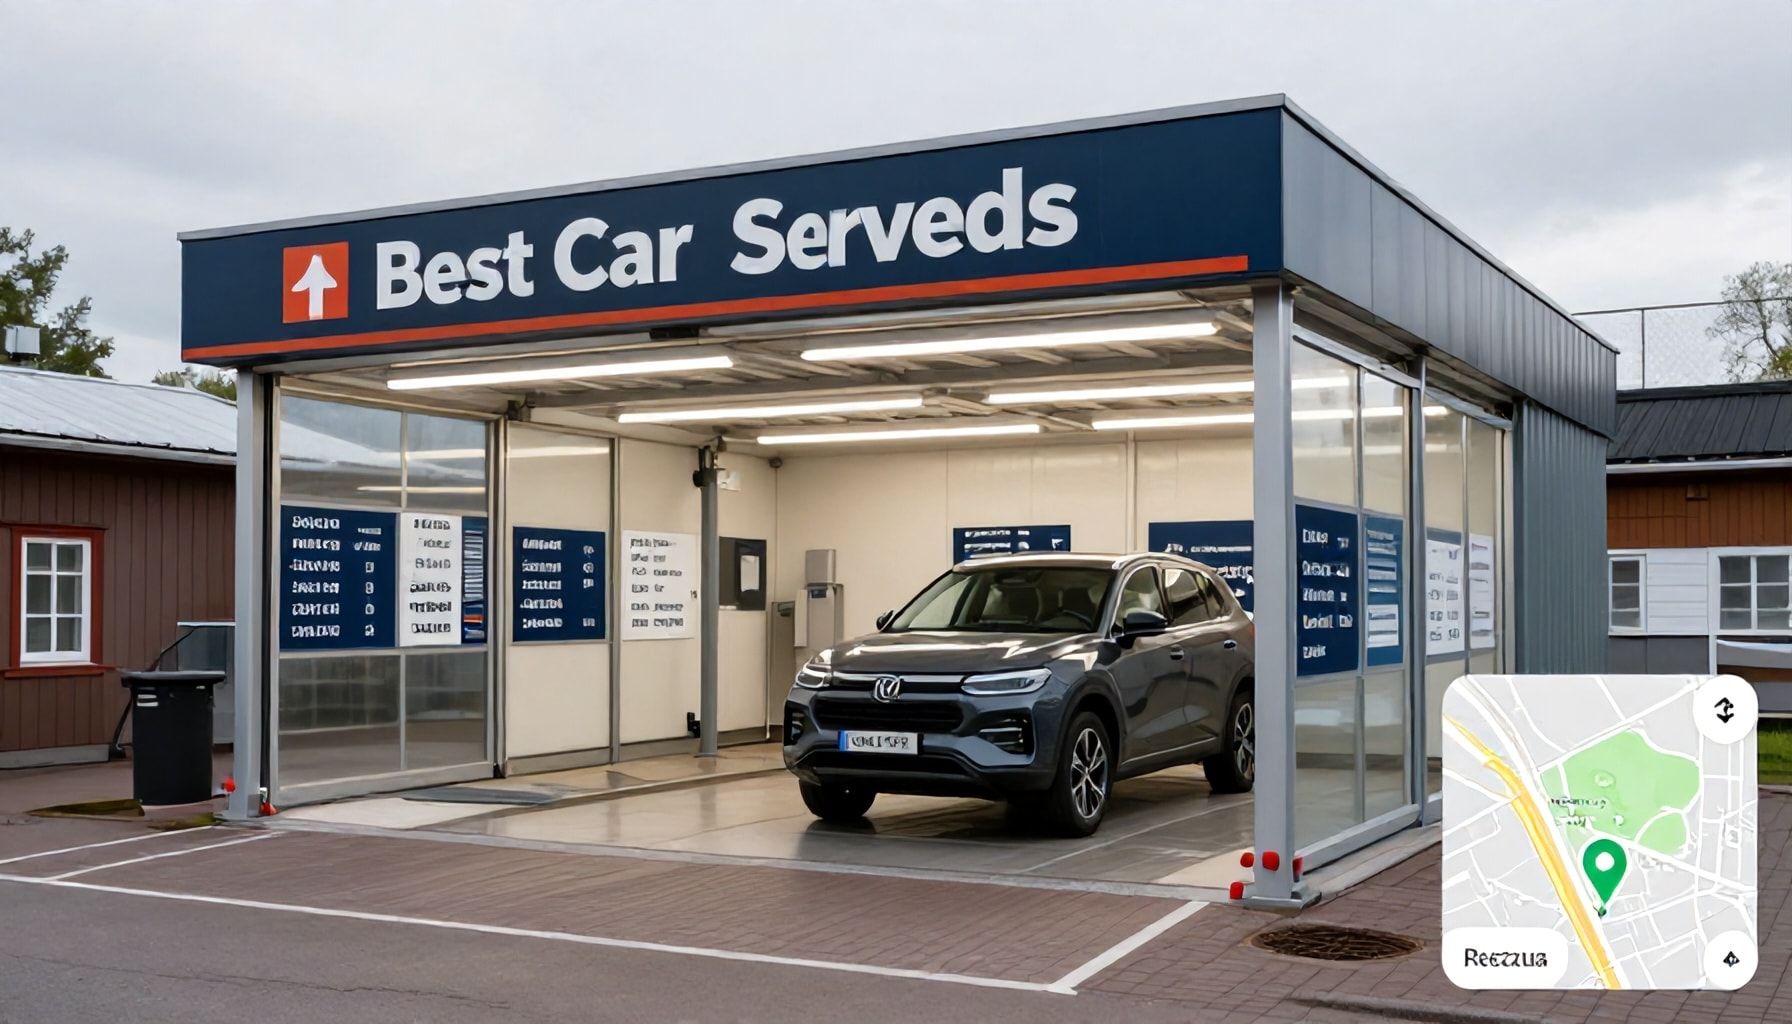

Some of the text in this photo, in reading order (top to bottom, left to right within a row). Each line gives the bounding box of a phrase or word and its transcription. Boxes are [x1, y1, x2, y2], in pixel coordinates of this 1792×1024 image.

[376, 167, 1079, 310] Best Car Serveds
